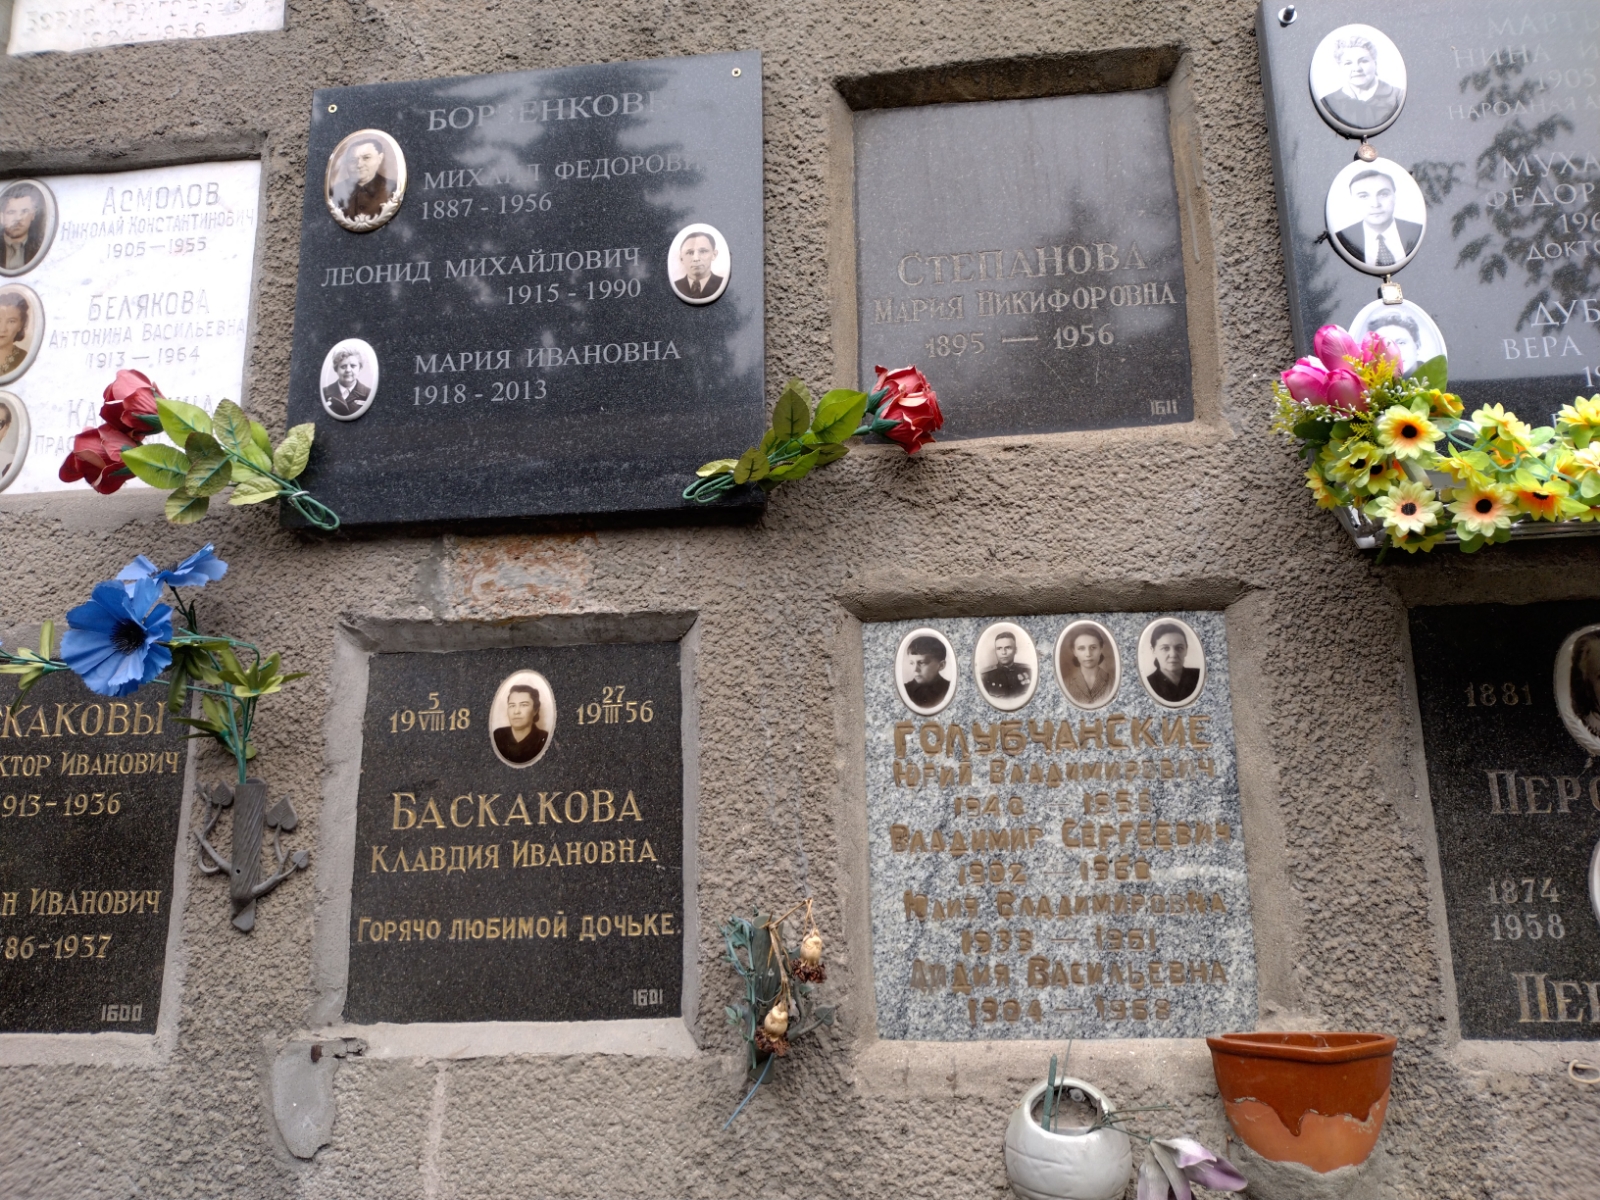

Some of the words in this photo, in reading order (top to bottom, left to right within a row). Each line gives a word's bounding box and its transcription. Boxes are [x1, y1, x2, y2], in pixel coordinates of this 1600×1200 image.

[1453, 43, 1551, 68] НИНА
[1534, 68, 1597, 90] 1905
[554, 151, 702, 181] ФЕДОРОВИ
[102, 182, 220, 215] АСМОЛОВ
[421, 198, 473, 220] 1887
[499, 192, 552, 214] 1956
[61, 215, 125, 241] НИКОЛАЙ
[129, 208, 254, 234] КОНСТАНТИНОВИЧ
[321, 260, 431, 287] ЛЕОНИД
[445, 247, 641, 279] МИХАЙЛОВИЧ
[897, 241, 1149, 286] СТЕПАНОВА
[88, 289, 209, 322] БЕЛЯКОВА
[506, 283, 559, 306] 1915
[587, 279, 641, 301] 1990
[873, 295, 964, 324] МАРИЯ
[978, 282, 1178, 317] НИКИФОРОВНА
[49, 325, 132, 349] АНТОНИНА
[142, 318, 246, 342] ВАСИЛЬЕВНА
[925, 333, 986, 358] 1895
[1053, 323, 1115, 350] 1956
[1503, 335, 1583, 360] ВЕРА
[415, 349, 511, 374] МАРИЯ
[526, 340, 681, 368] ИВАНОВНА
[412, 384, 466, 406] 1918
[492, 380, 547, 402] 2013
[1150, 398, 1179, 417] 1611
[1466, 682, 1534, 708] 1881
[0, 700, 167, 738] КАКОВЫ
[893, 714, 1212, 760] ГОЛУБЧАНСКИЕ
[61, 751, 180, 776] ИВАНОВИЧ
[893, 760, 973, 788] ЮРИЙ
[990, 756, 1214, 787] ВЛАДИМИРОВИЧ
[391, 789, 643, 830] БАСКАКОВА
[890, 823, 1043, 857] ВЛАДИМИР
[1061, 817, 1231, 851] СЕРГЕЕВИЧ
[371, 843, 500, 874] КЛАВДИЯ
[512, 838, 658, 868] ИВАНОВНА
[30, 888, 163, 916] ИВАНОВИЧ
[903, 889, 978, 922] ЮЛИЯ
[996, 889, 1227, 920] ВЛАДИМИРОВНА
[1487, 877, 1560, 904] 1874
[357, 916, 441, 942] ГОРЯЧО
[449, 911, 567, 940] ЛЮБИМОЙ
[1491, 913, 1566, 941] 1958
[909, 958, 1010, 994] ЛИДИЯ
[1027, 955, 1227, 989] ВАСИЛЬЕВНА
[101, 1003, 143, 1022] 1600
[633, 988, 663, 1006] 1601
